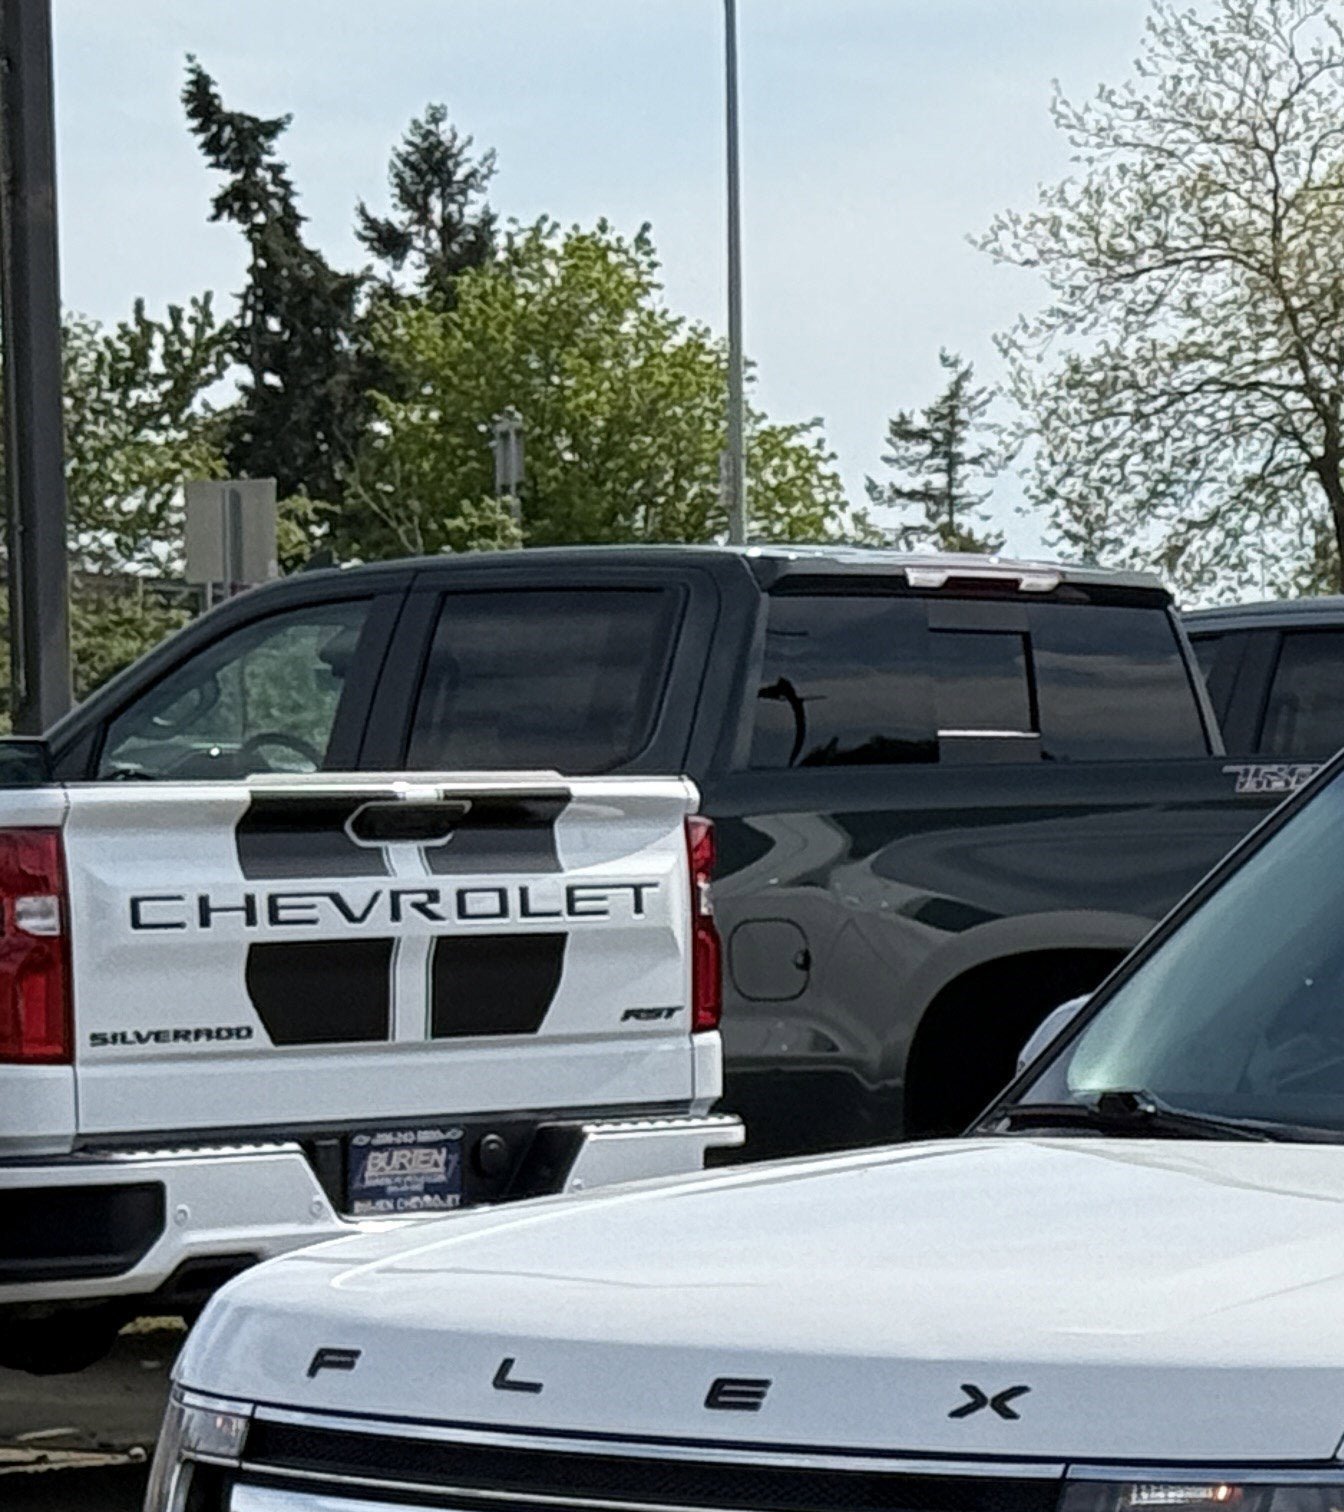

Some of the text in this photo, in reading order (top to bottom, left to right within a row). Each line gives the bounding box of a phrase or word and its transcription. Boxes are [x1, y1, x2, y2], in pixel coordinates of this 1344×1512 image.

[129, 881, 660, 930] CHEVROLET
[620, 1005, 685, 1022] RST
[89, 1025, 253, 1048] SILVERADO
